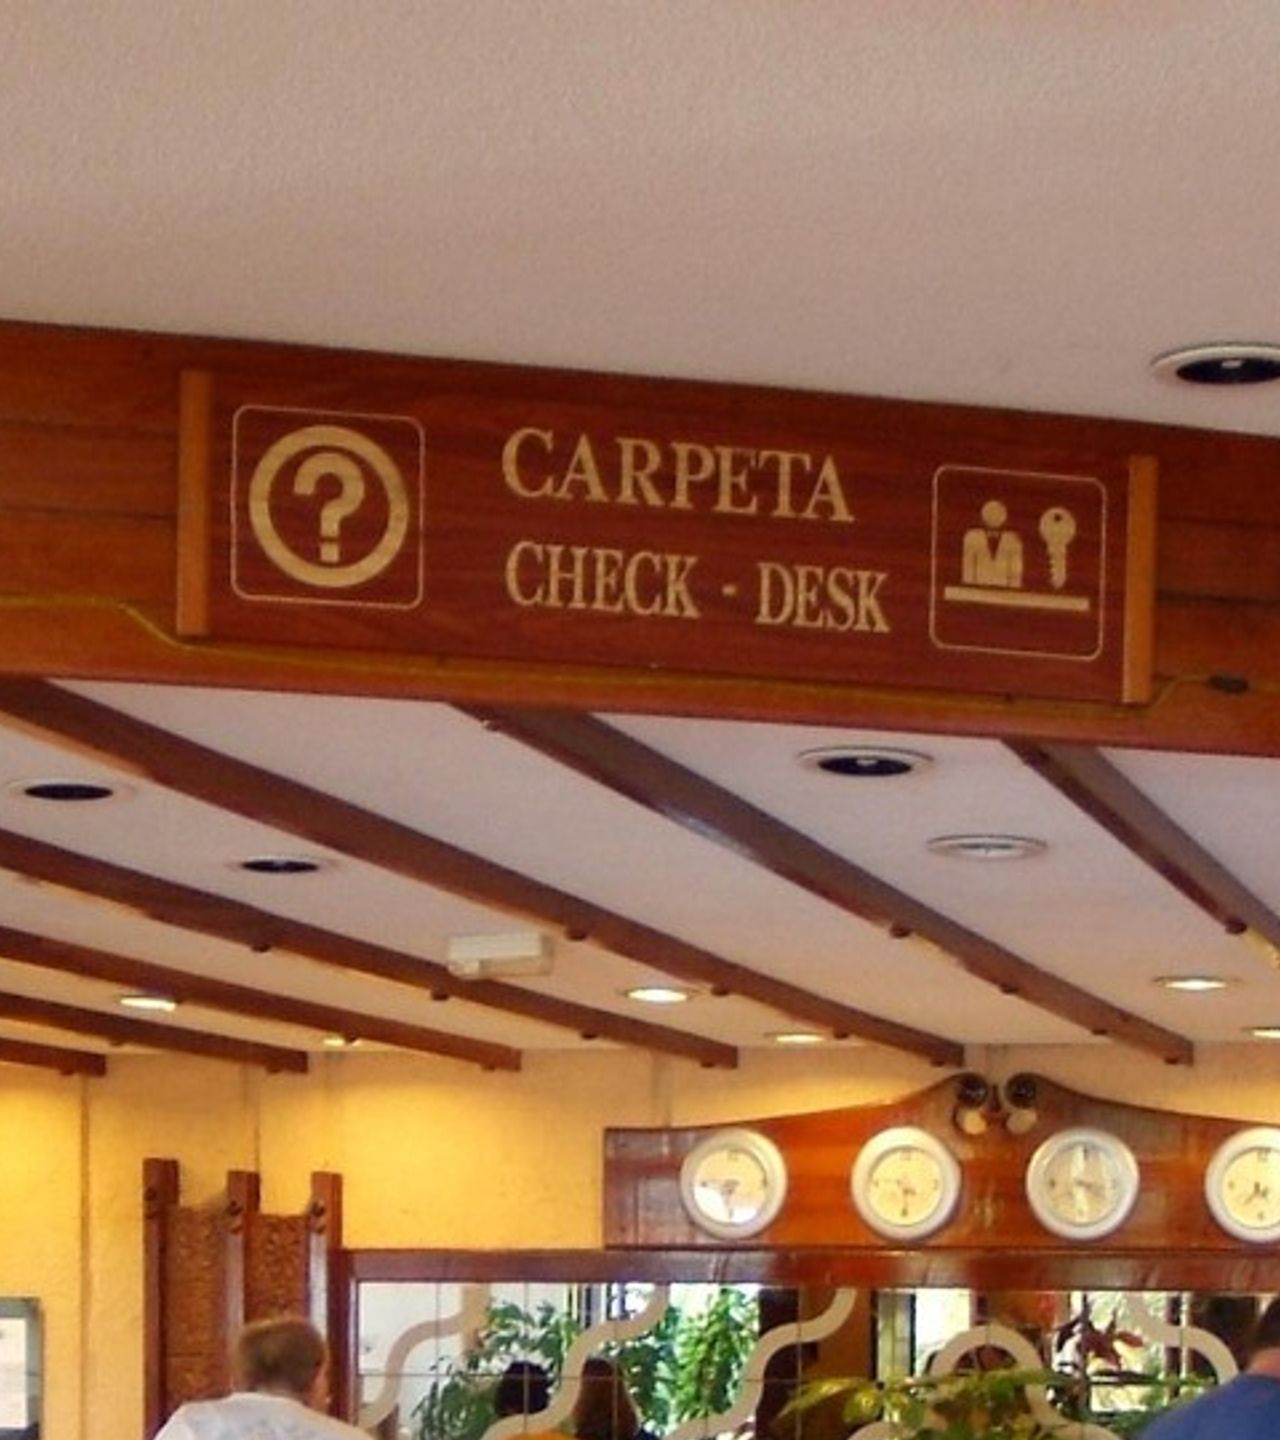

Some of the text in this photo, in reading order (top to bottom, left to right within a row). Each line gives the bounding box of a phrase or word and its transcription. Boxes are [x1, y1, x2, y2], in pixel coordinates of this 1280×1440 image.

[501, 426, 856, 523] CARPETA
[505, 540, 701, 620] CHECK
[754, 561, 891, 634] DESK
